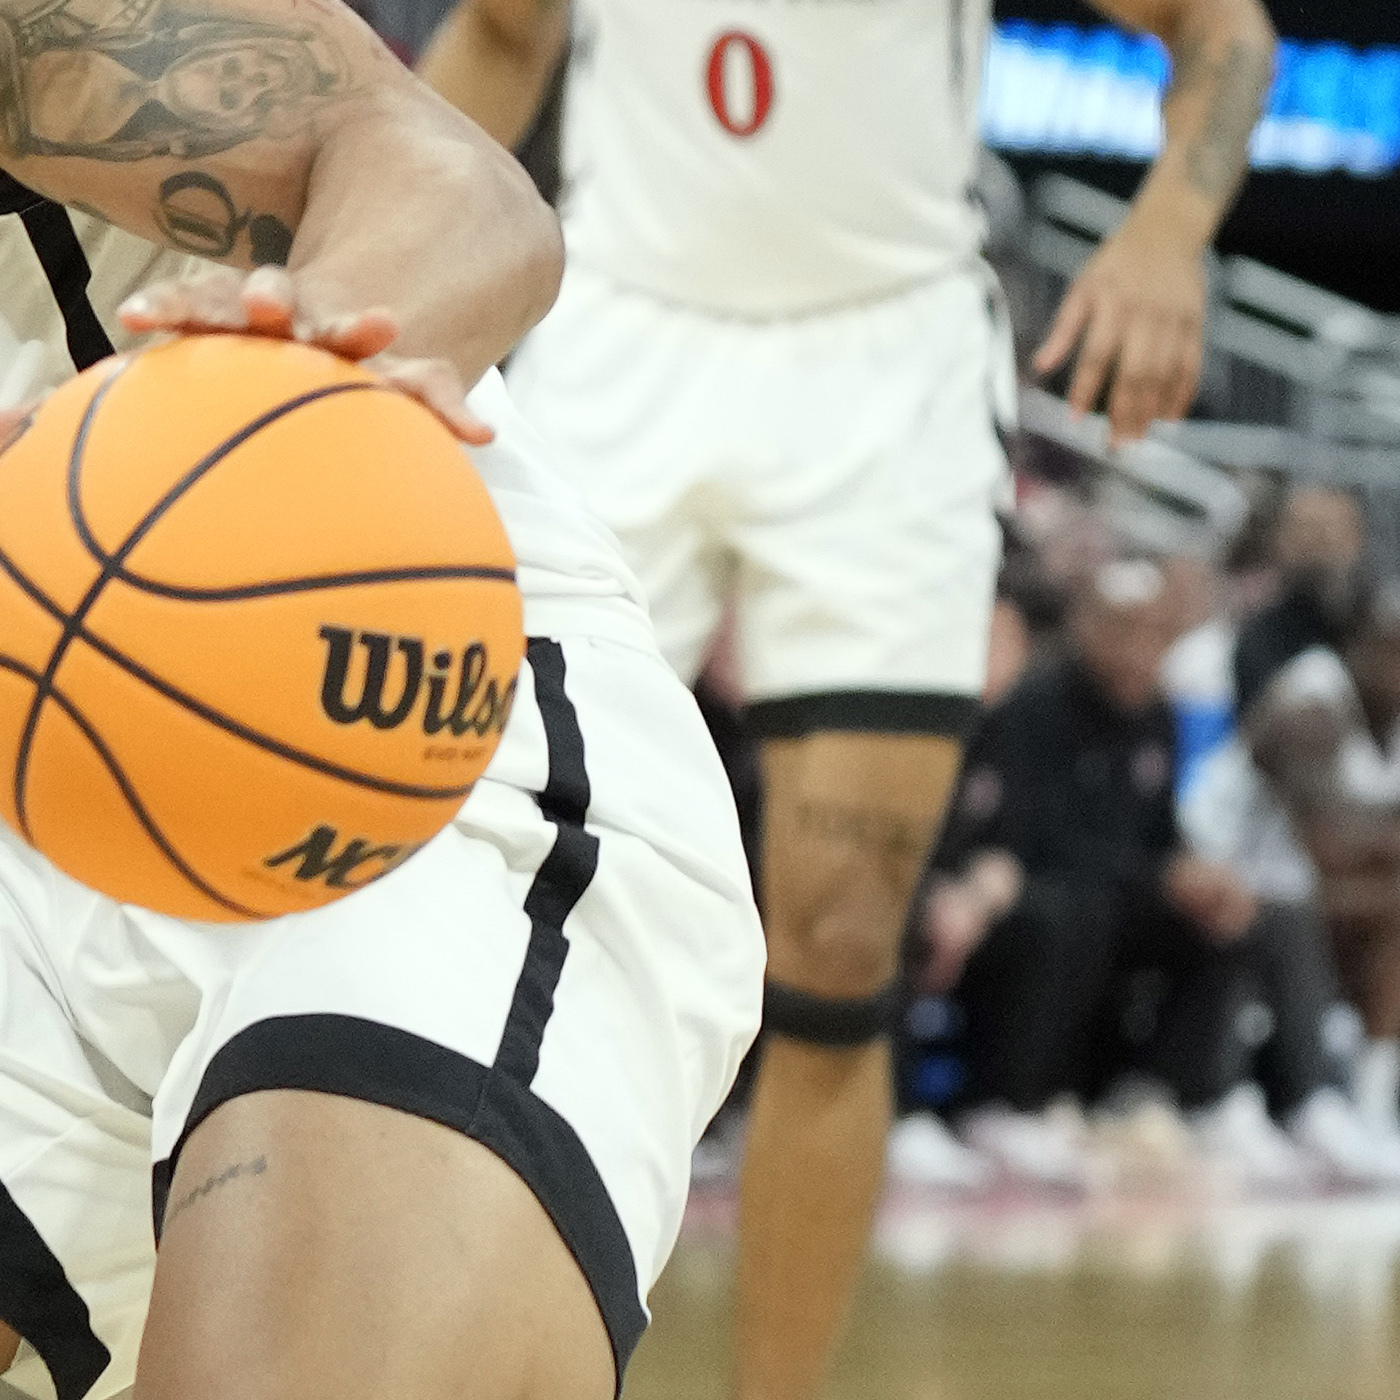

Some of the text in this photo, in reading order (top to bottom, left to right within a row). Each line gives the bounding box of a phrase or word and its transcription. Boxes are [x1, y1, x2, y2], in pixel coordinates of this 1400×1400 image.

[703, 28, 777, 140] 0
[317, 622, 518, 737] Wils
[263, 823, 428, 890] NC
